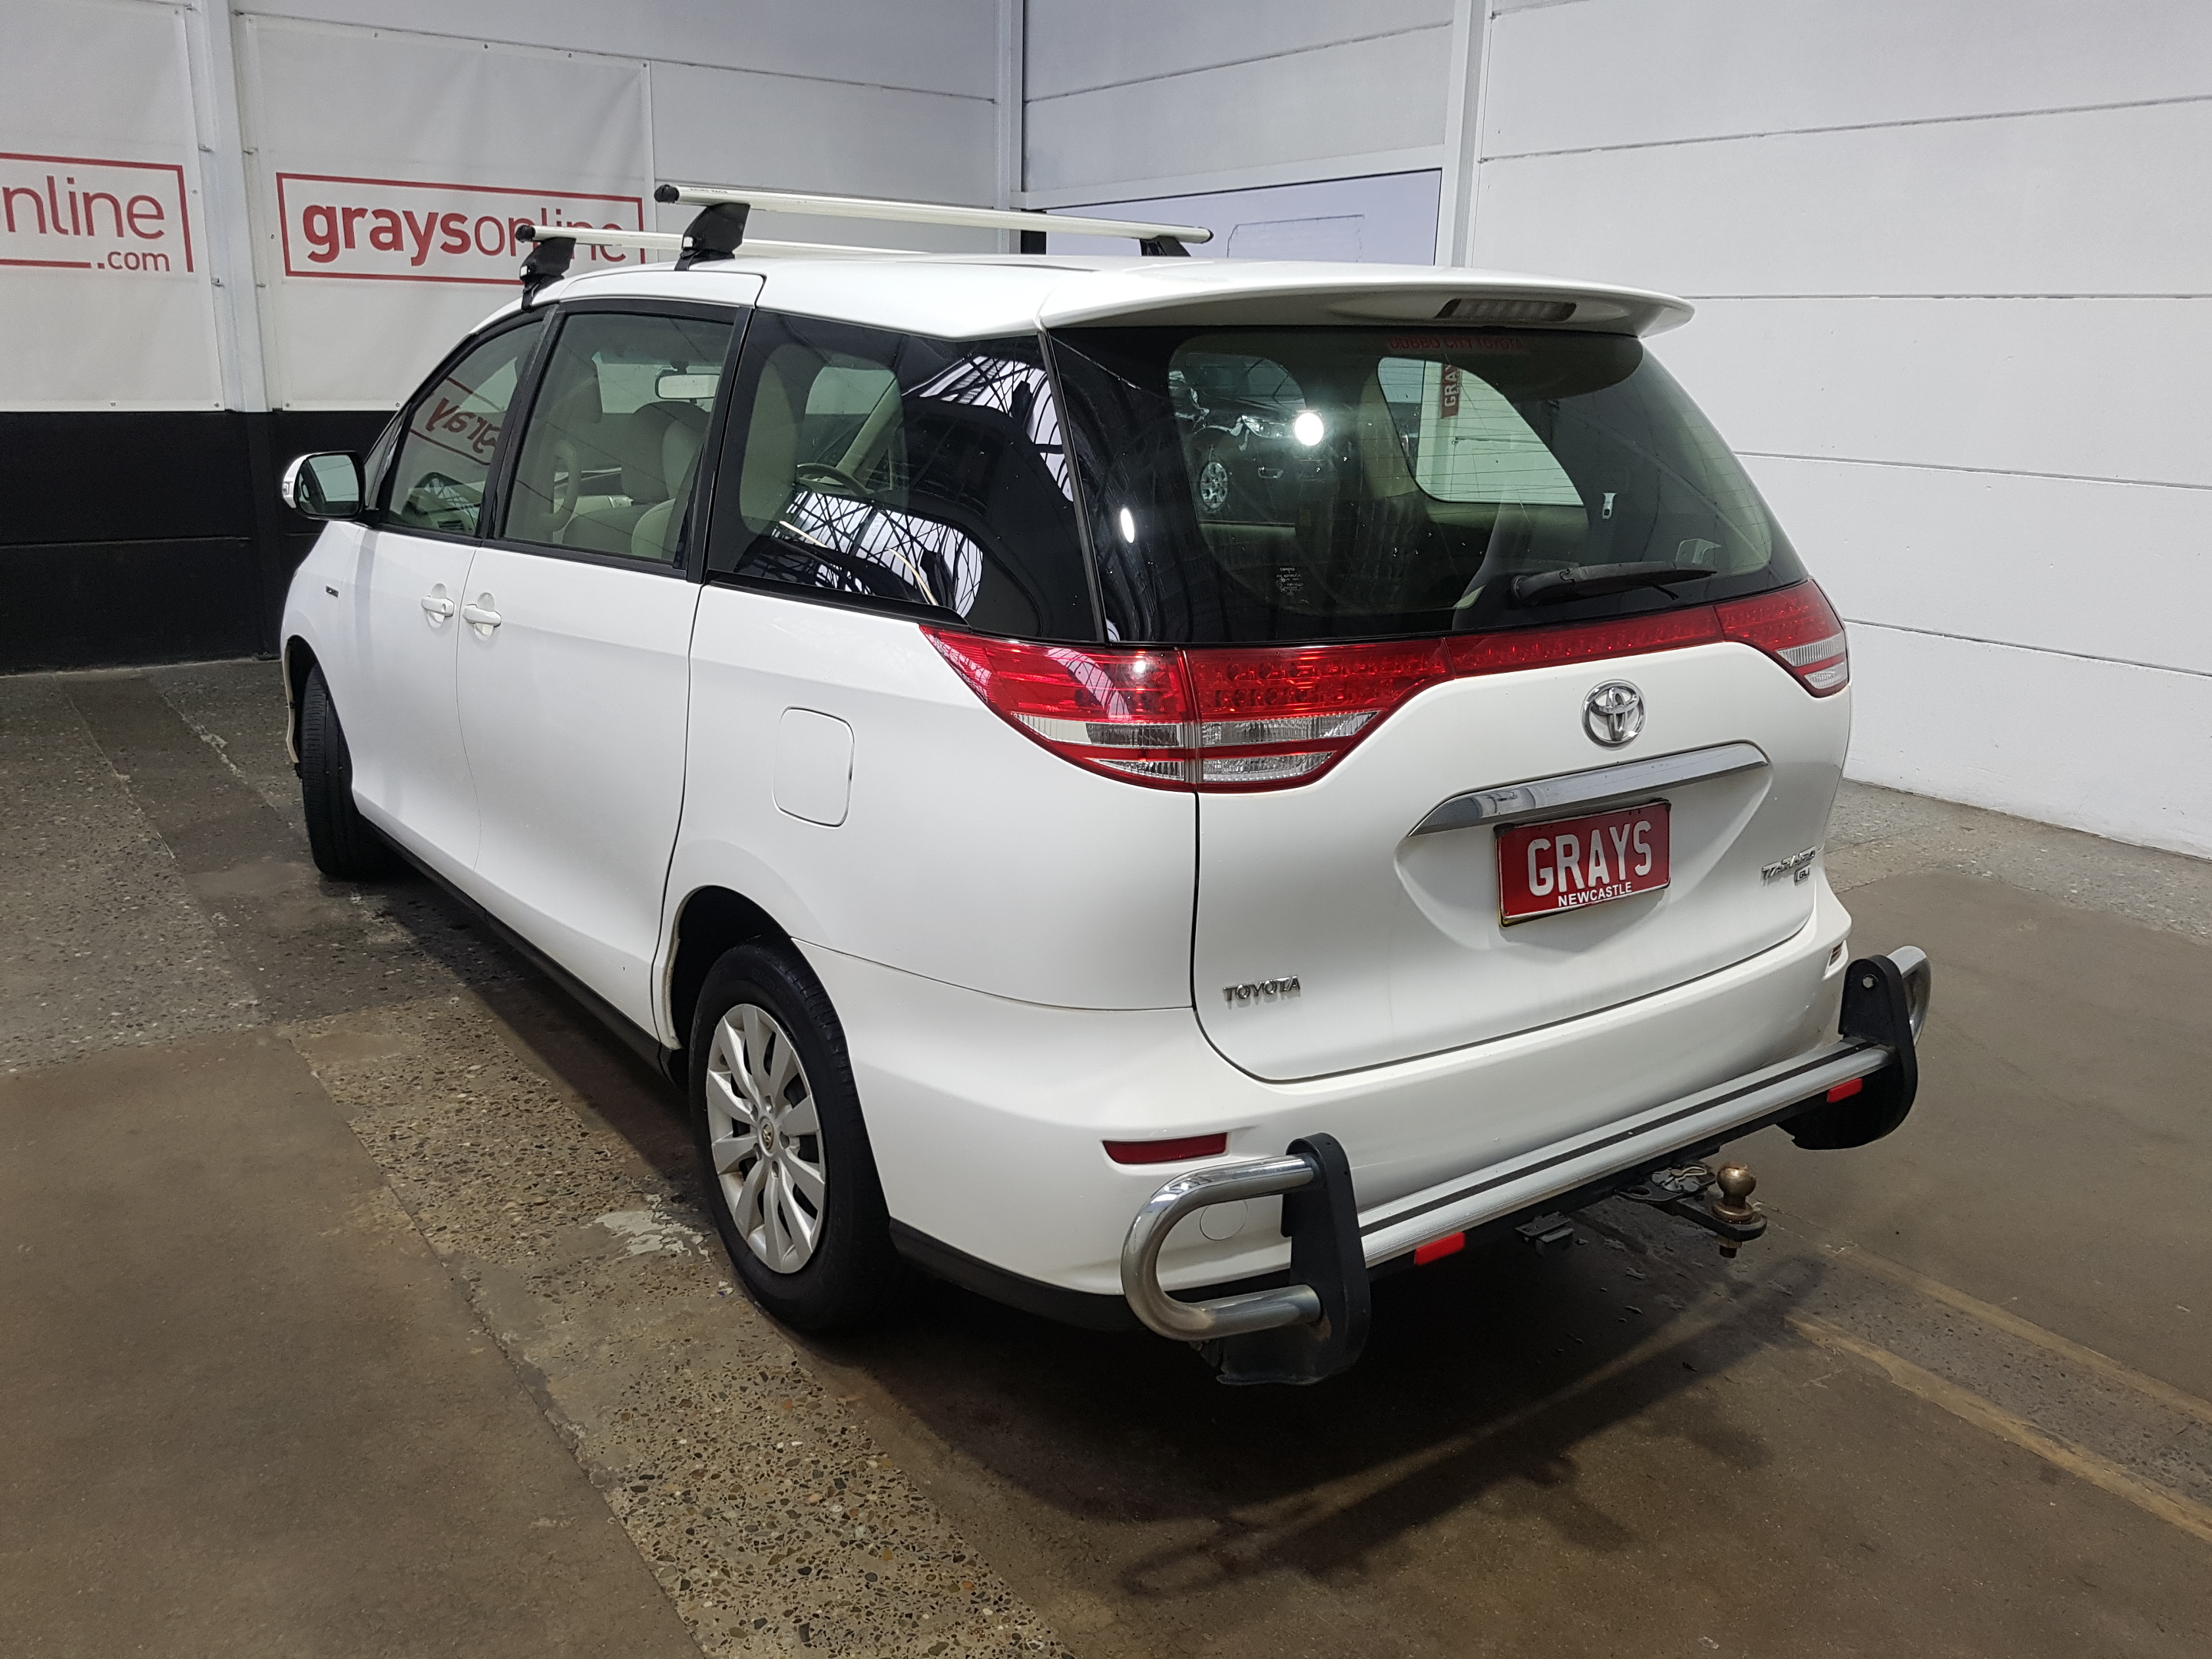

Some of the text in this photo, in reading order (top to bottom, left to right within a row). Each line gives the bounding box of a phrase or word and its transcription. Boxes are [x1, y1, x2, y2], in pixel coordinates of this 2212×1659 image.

[98, 250, 171, 272] .com
[1527, 820, 1652, 897] GRAYS
[1558, 881, 1633, 907] NEWCASTLE
[1223, 975, 1300, 1002] TOYOTA
